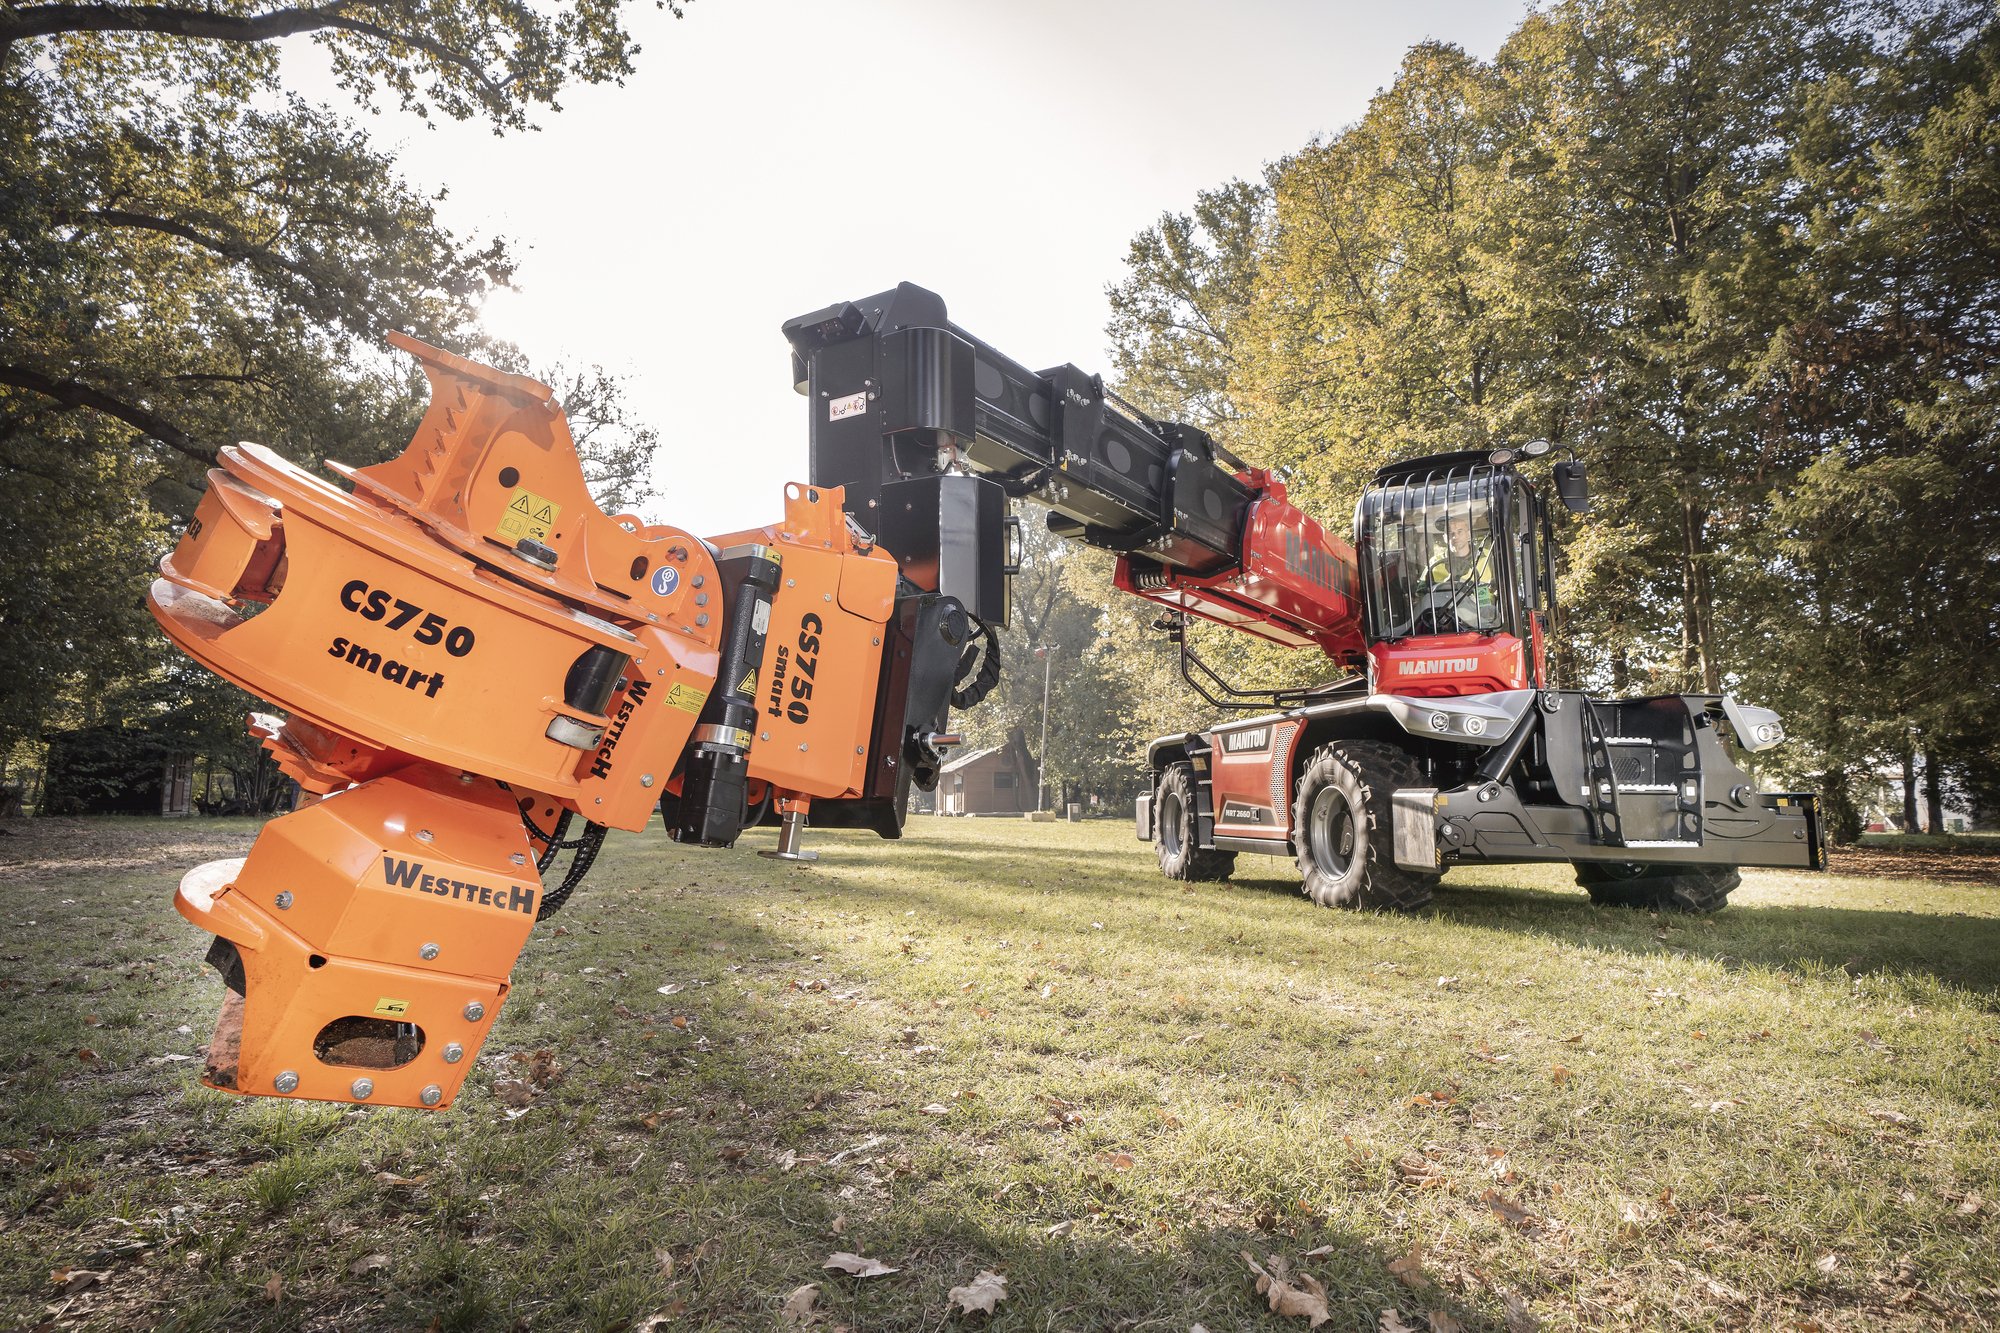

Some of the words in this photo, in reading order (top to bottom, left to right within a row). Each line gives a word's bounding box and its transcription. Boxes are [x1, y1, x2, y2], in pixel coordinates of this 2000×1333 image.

[341, 580, 475, 659] CS750
[328, 637, 446, 698] smart
[767, 645, 788, 719] smart
[786, 612, 823, 725] CS750
[1399, 658, 1478, 675] MANITOU
[1229, 729, 1267, 751] MANITOU
[1225, 809, 1237, 817] MRT
